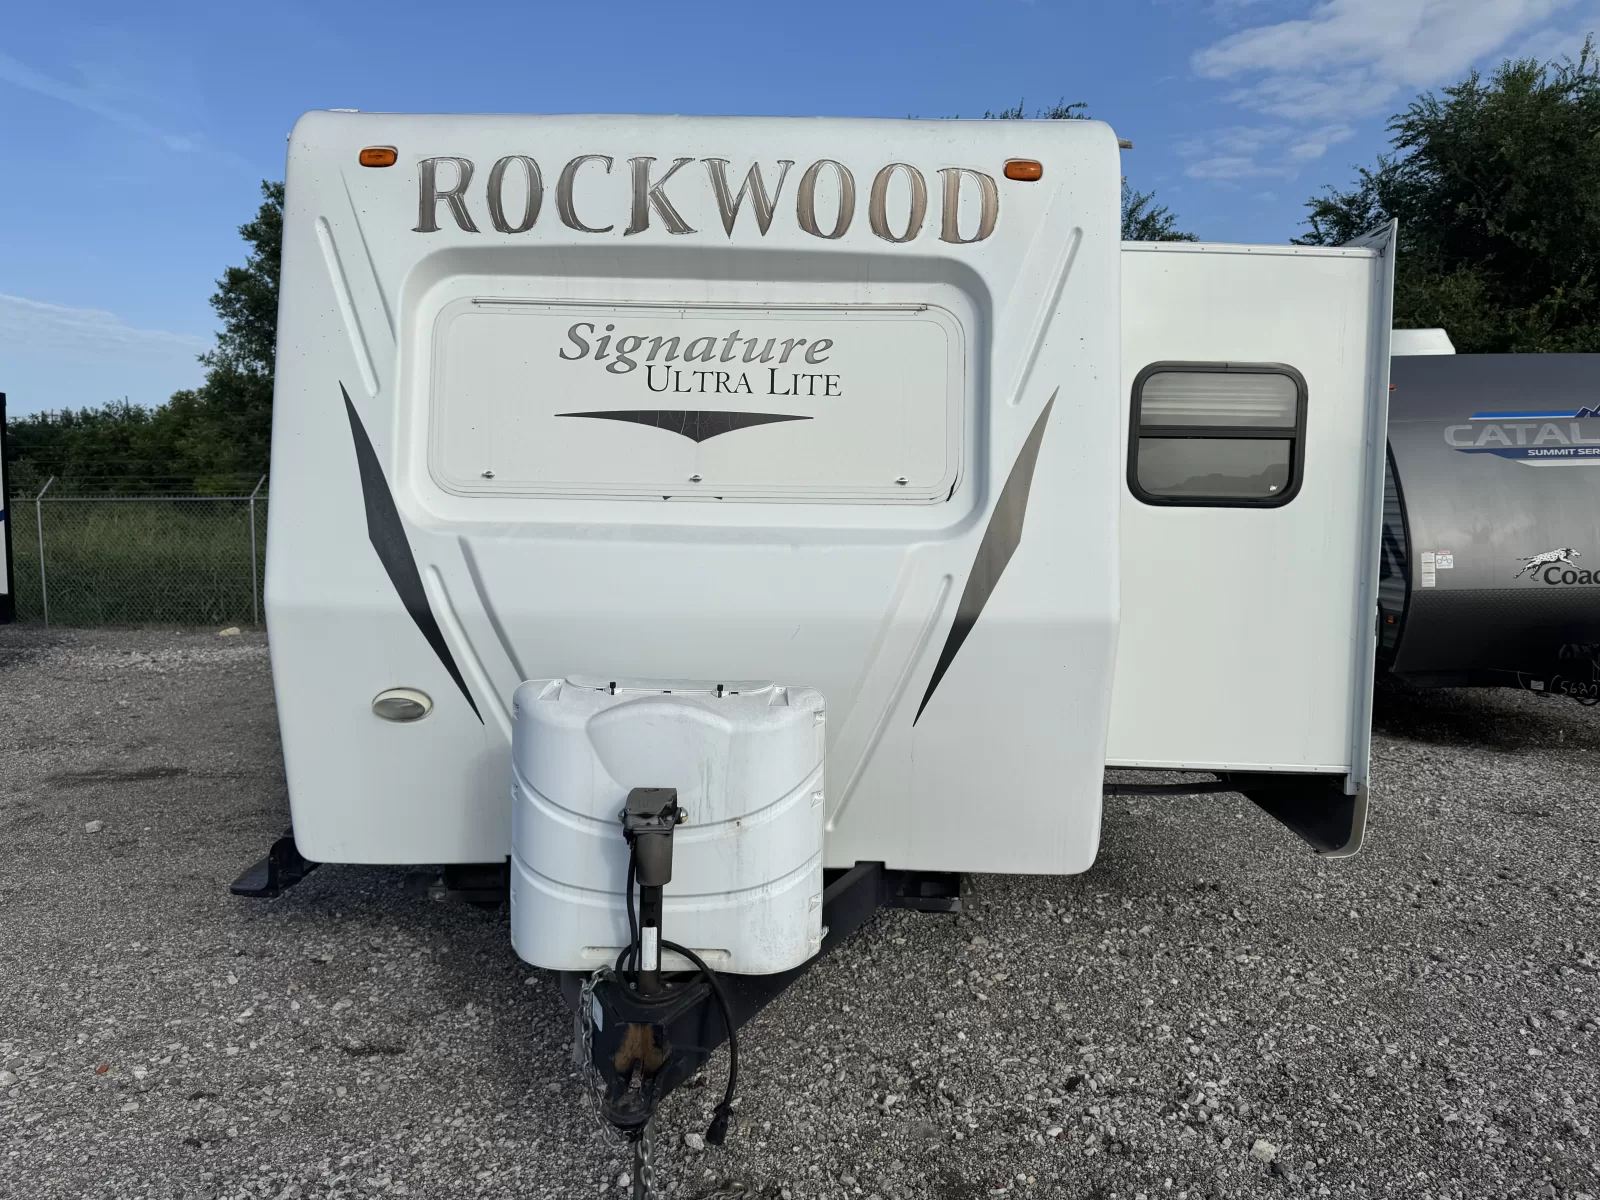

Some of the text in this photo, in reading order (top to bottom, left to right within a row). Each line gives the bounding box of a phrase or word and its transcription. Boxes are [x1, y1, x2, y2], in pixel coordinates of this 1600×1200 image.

[410, 154, 1000, 244] ROCKWOOD
[558, 322, 834, 374] Signature
[645, 365, 842, 396] ULTRA LITE
[1443, 422, 1600, 447] CATAL
[1527, 448, 1575, 456] SUMMIT
